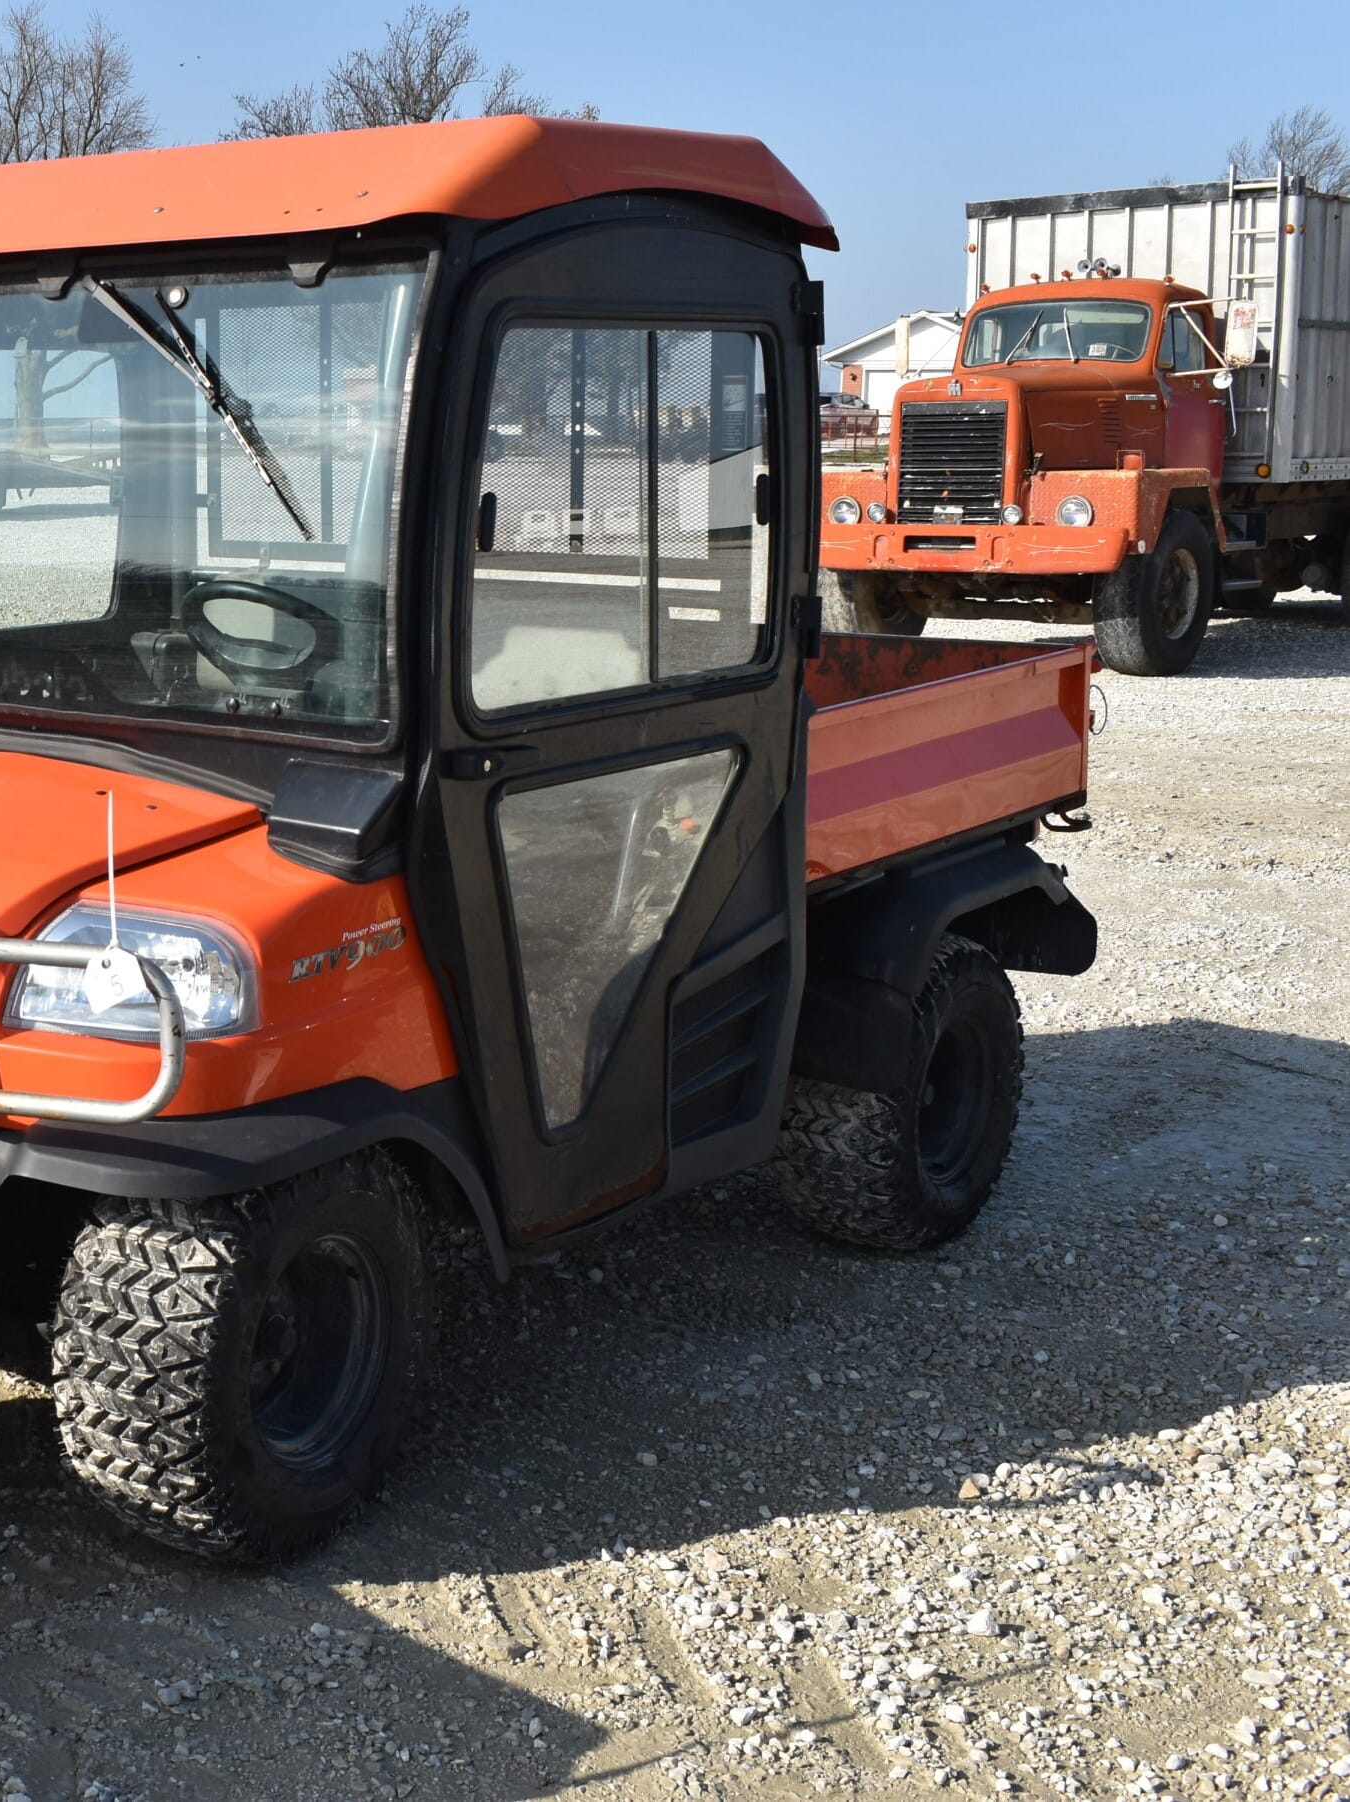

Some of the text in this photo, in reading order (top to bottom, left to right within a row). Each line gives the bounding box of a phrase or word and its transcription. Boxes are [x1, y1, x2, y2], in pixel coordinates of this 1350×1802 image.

[341, 917, 402, 942] Power Steering
[288, 926, 406, 984] RTV900
